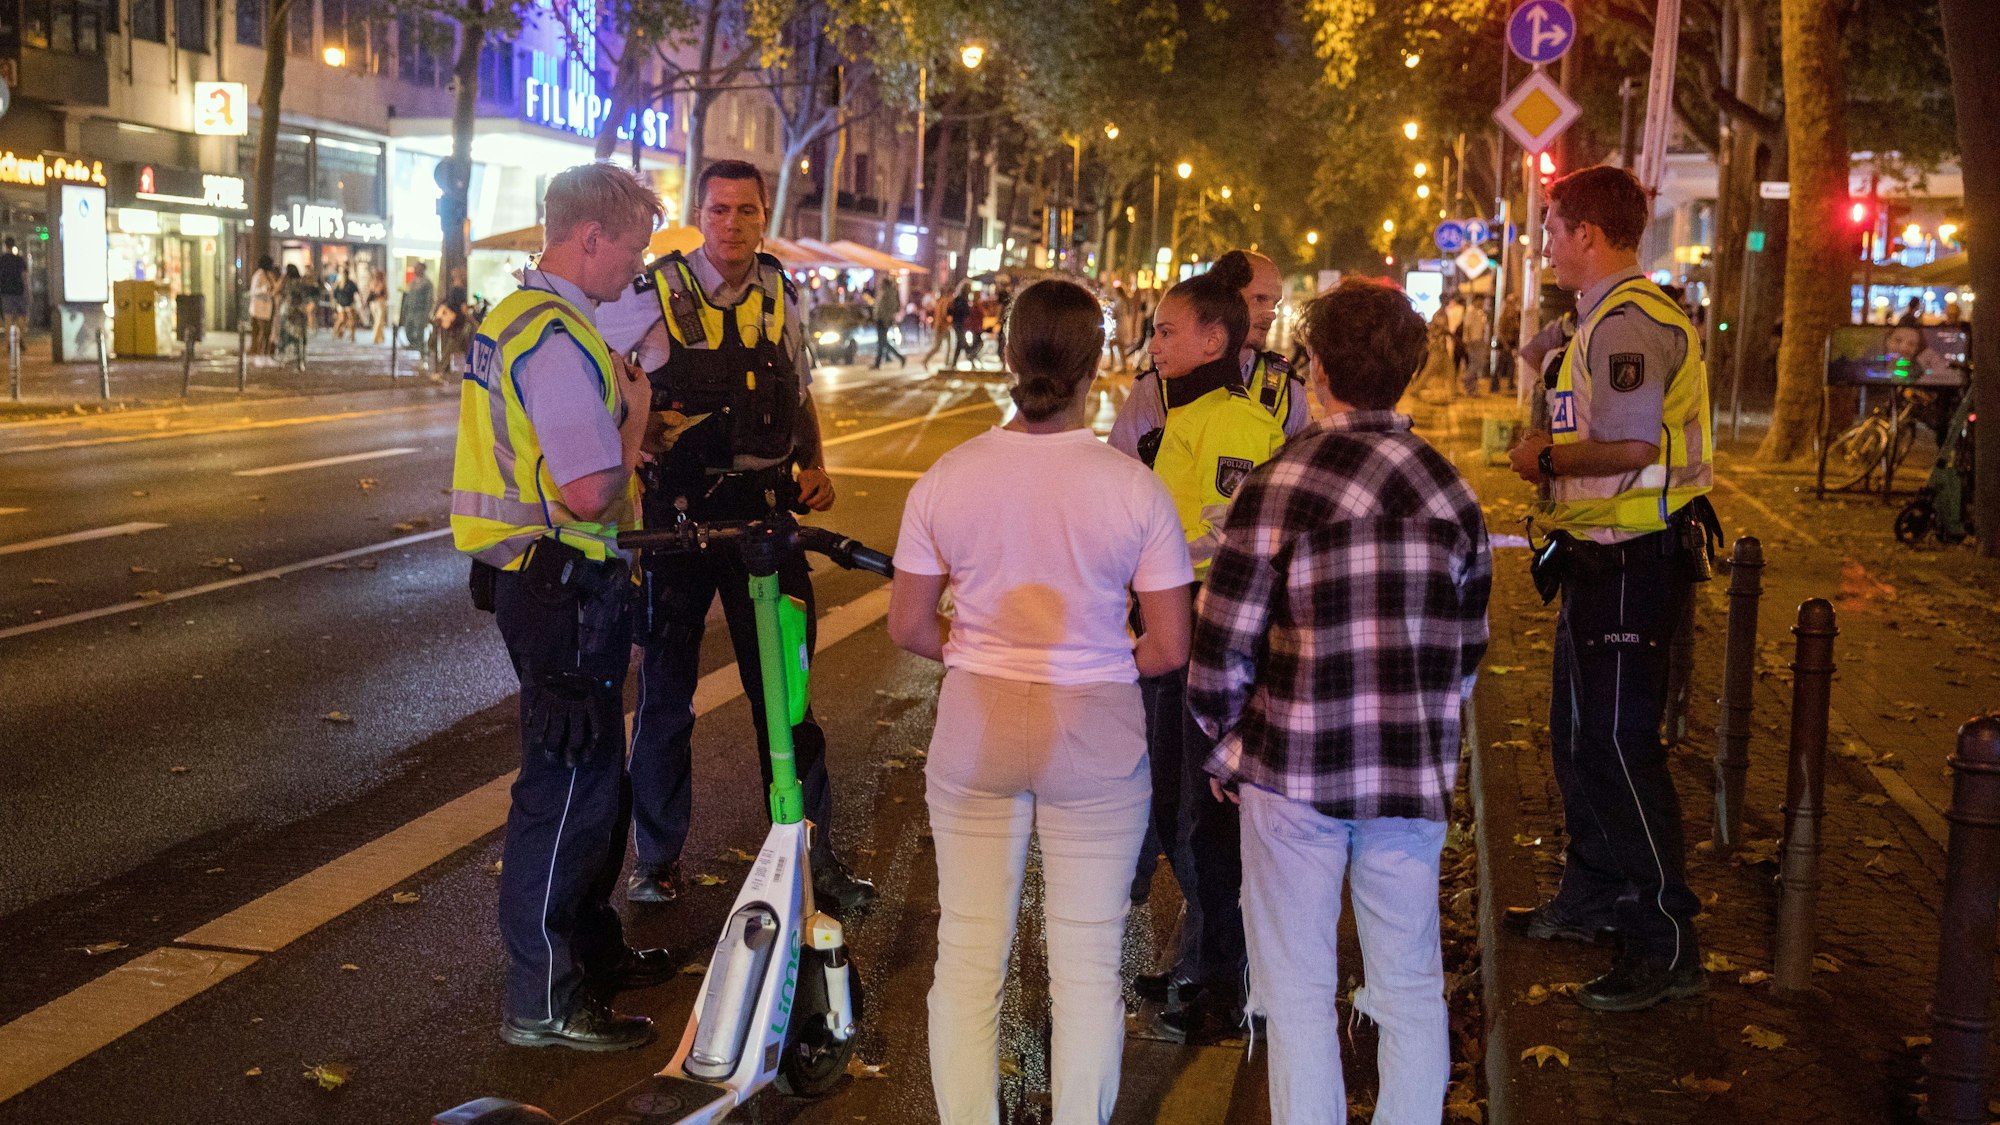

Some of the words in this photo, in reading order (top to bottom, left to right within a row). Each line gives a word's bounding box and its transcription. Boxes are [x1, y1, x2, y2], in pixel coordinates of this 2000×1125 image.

[526, 76, 669, 148] FILMPST
[1604, 632, 1640, 644] POLIZEI
[771, 929, 800, 1034] Lime
